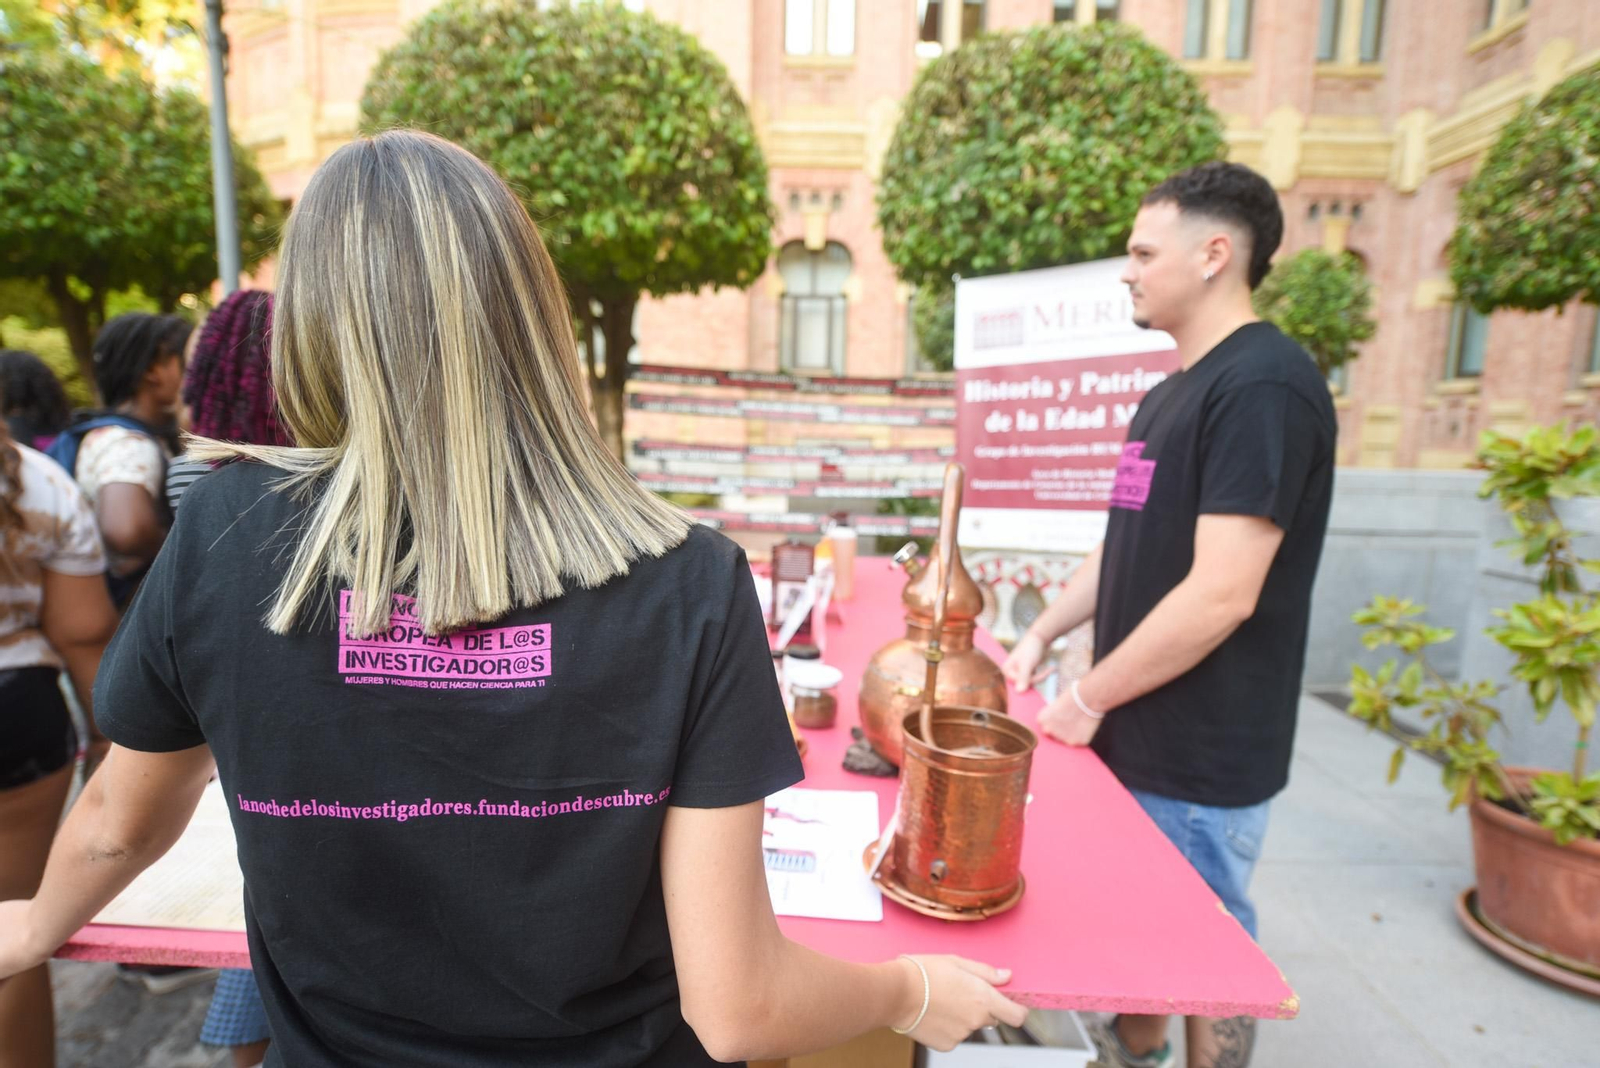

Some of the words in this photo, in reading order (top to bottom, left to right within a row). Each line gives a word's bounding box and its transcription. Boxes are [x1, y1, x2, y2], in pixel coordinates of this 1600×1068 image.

[965, 376, 1053, 402] Historia
[1058, 378, 1074, 402] y
[985, 410, 1012, 433] de
[1016, 409, 1039, 431] la
[1045, 405, 1106, 430] Edad
[464, 633, 492, 651] DE
[500, 629, 545, 650] L@S
[345, 651, 545, 675] INVESTIGADOR@S
[345, 676, 384, 685] MUJERES
[391, 678, 429, 689] HOMBRES
[430, 681, 449, 689] QUE
[450, 681, 479, 689] HACEN
[480, 681, 513, 689] CIENCIA
[514, 681, 536, 689] PARA
[537, 679, 545, 687] TI
